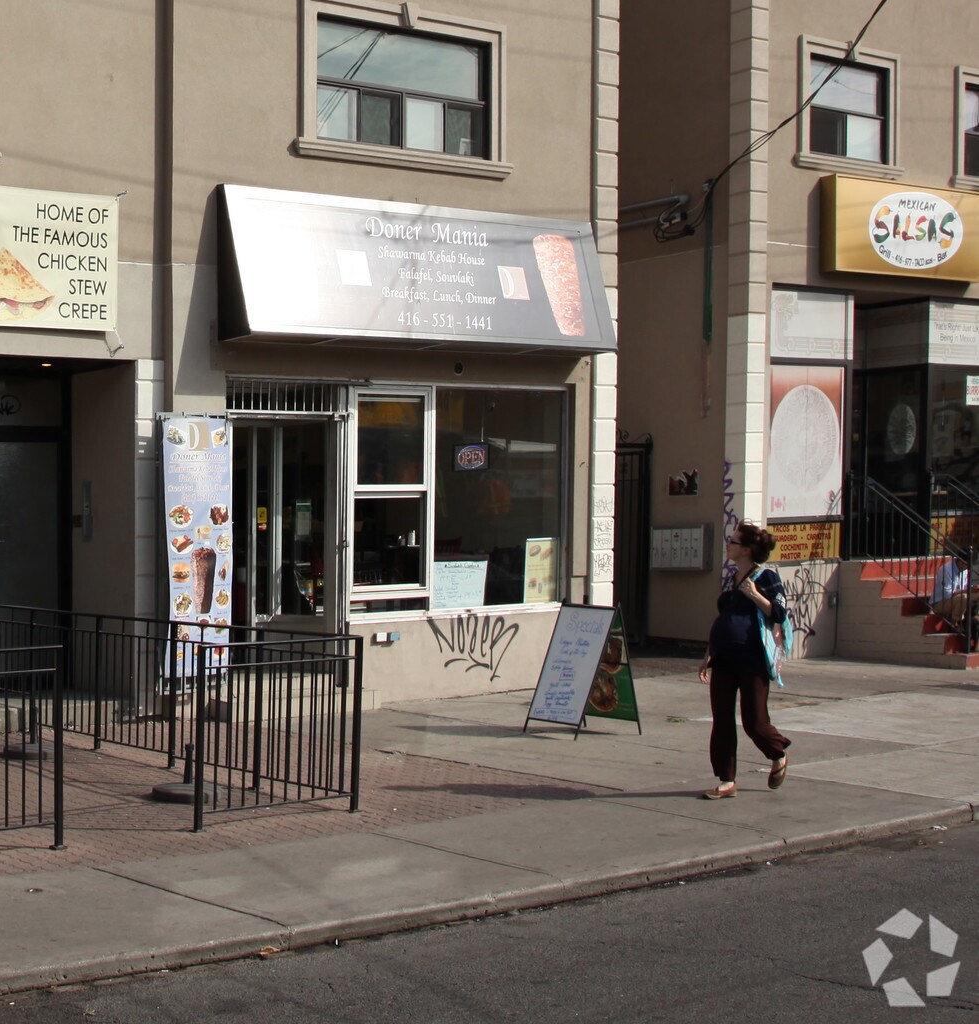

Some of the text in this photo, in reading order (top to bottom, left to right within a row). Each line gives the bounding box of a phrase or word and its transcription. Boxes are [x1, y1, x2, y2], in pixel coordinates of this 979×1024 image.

[36, 203, 109, 224] HOME OF
[898, 198, 936, 212] MEXICAN
[13, 225, 108, 249] THE FAMOUS
[365, 216, 489, 248] Doner Mania
[871, 205, 956, 250] SALSAS
[37, 252, 108, 272] CHICKEN
[427, 250, 456, 265] Kebab
[457, 252, 486, 266] House
[878, 244, 892, 259] Grill
[936, 250, 948, 262] Bar
[397, 267, 475, 287] Falafel, Souvlaki
[68, 278, 108, 296] STEW
[381, 286, 497, 305] Breakfast, Lunch, Dinner
[58, 302, 108, 320] CREPE
[397, 311, 420, 327] 416
[465, 315, 493, 330] 1441
[772, 524, 790, 533] TACOS
[792, 524, 797, 532] A
[780, 552, 801, 560] PASTOR
